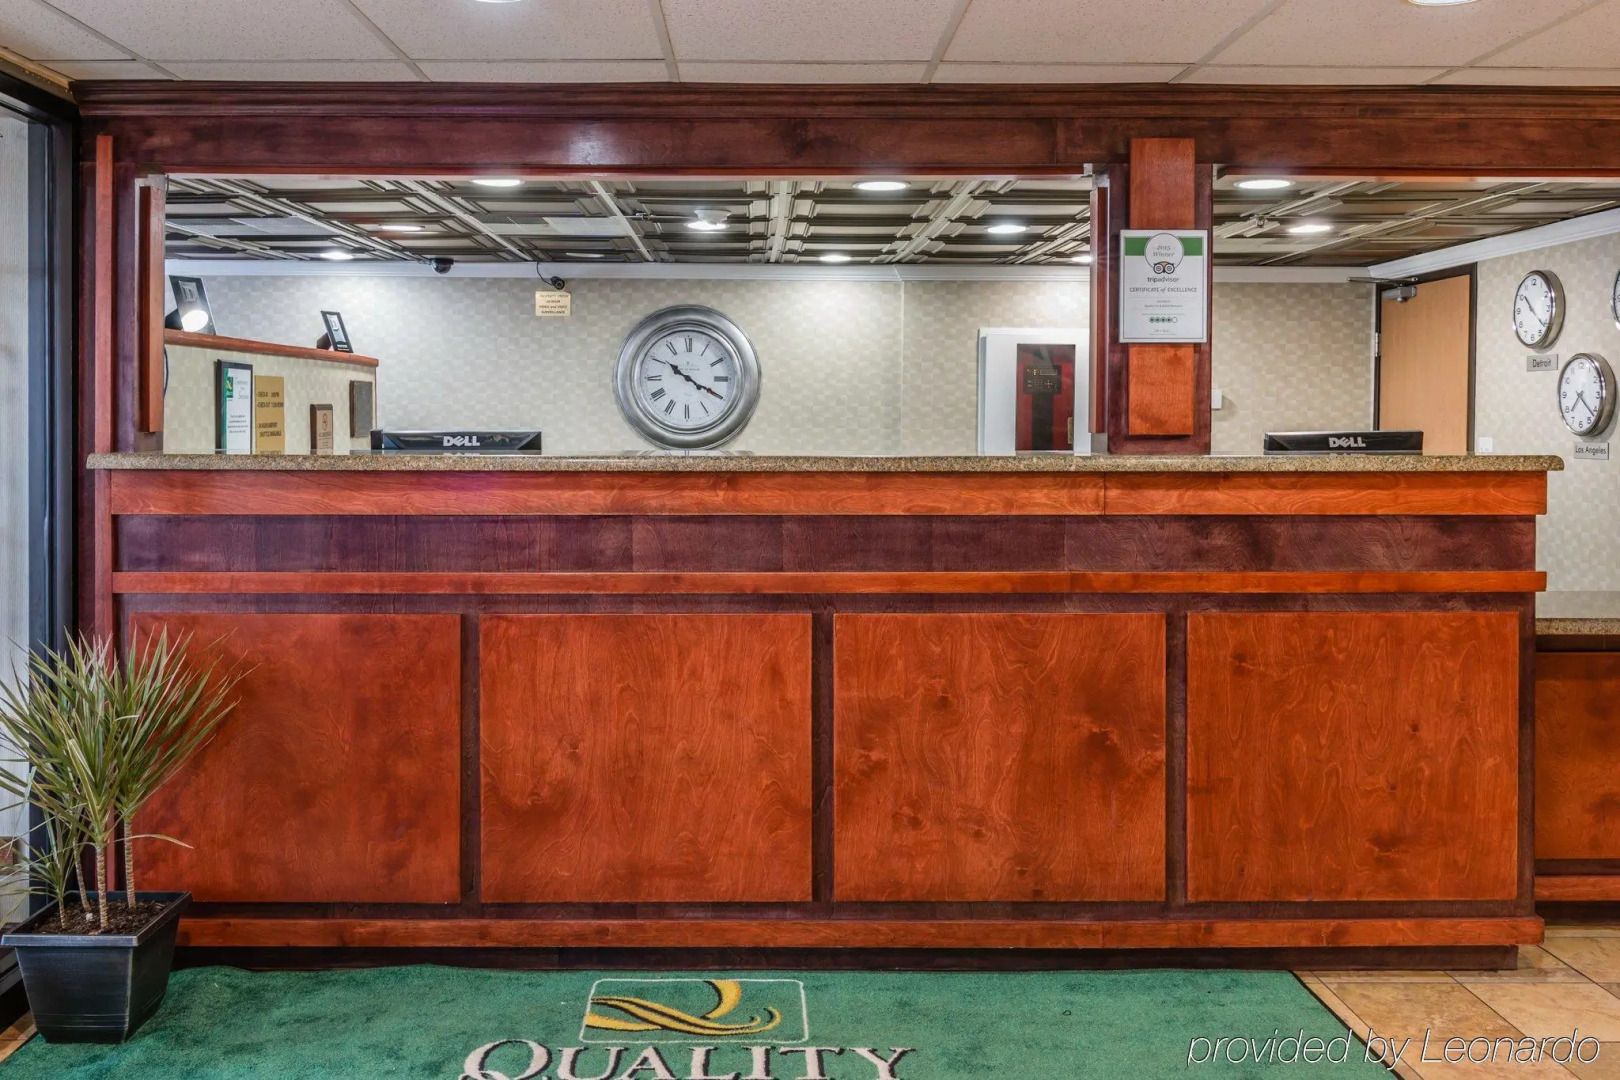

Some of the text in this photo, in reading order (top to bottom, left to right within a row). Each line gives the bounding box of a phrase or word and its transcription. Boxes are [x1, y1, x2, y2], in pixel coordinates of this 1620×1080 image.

[1532, 359, 1552, 368] Detroit
[443, 435, 480, 447] DELL
[1328, 436, 1367, 448] DELL
[1575, 445, 1607, 455] Los Angeles
[458, 1037, 917, 1080] QUALITY
